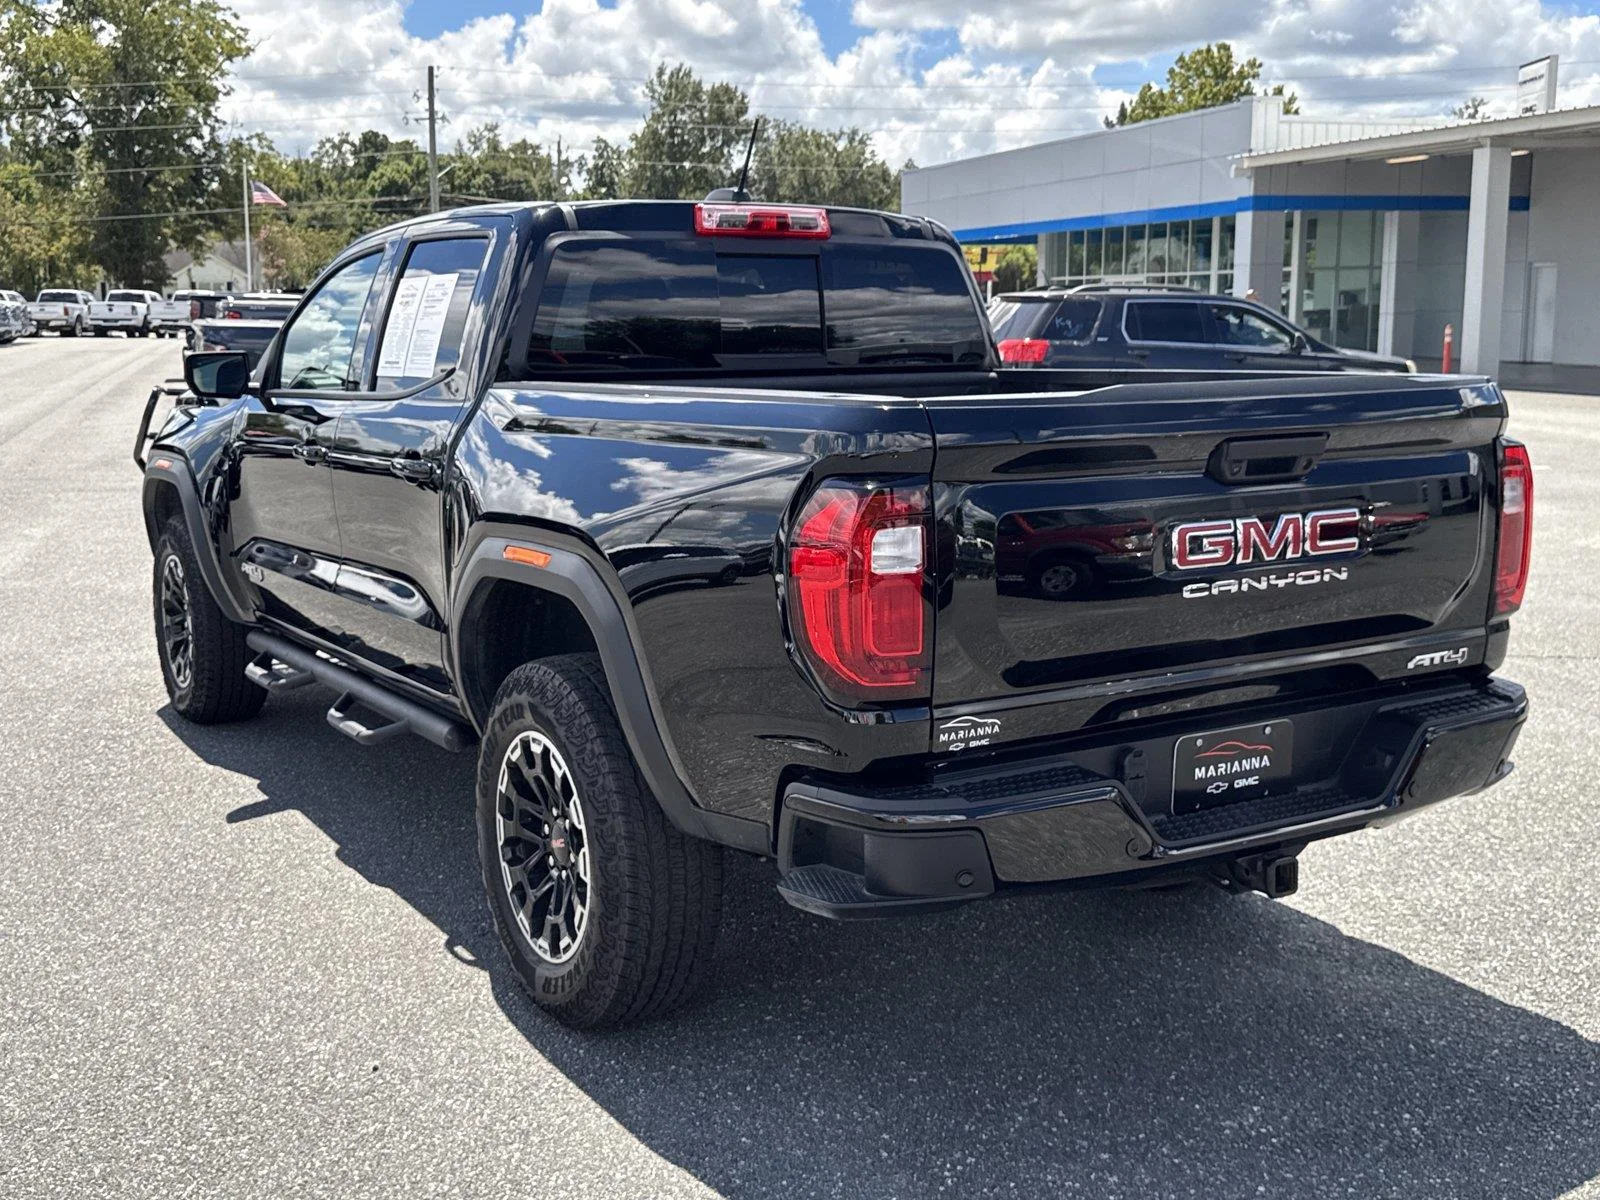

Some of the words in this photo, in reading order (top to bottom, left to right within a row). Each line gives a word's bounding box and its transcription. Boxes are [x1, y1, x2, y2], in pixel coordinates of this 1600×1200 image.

[1172, 508, 1360, 570] GMC
[1182, 566, 1348, 599] CANYON
[1407, 647, 1468, 669] AT4
[939, 724, 1000, 742] MARIANNA
[969, 738, 990, 747] GMC
[1194, 755, 1271, 780] MARIANNA
[1233, 776, 1260, 788] GMC
